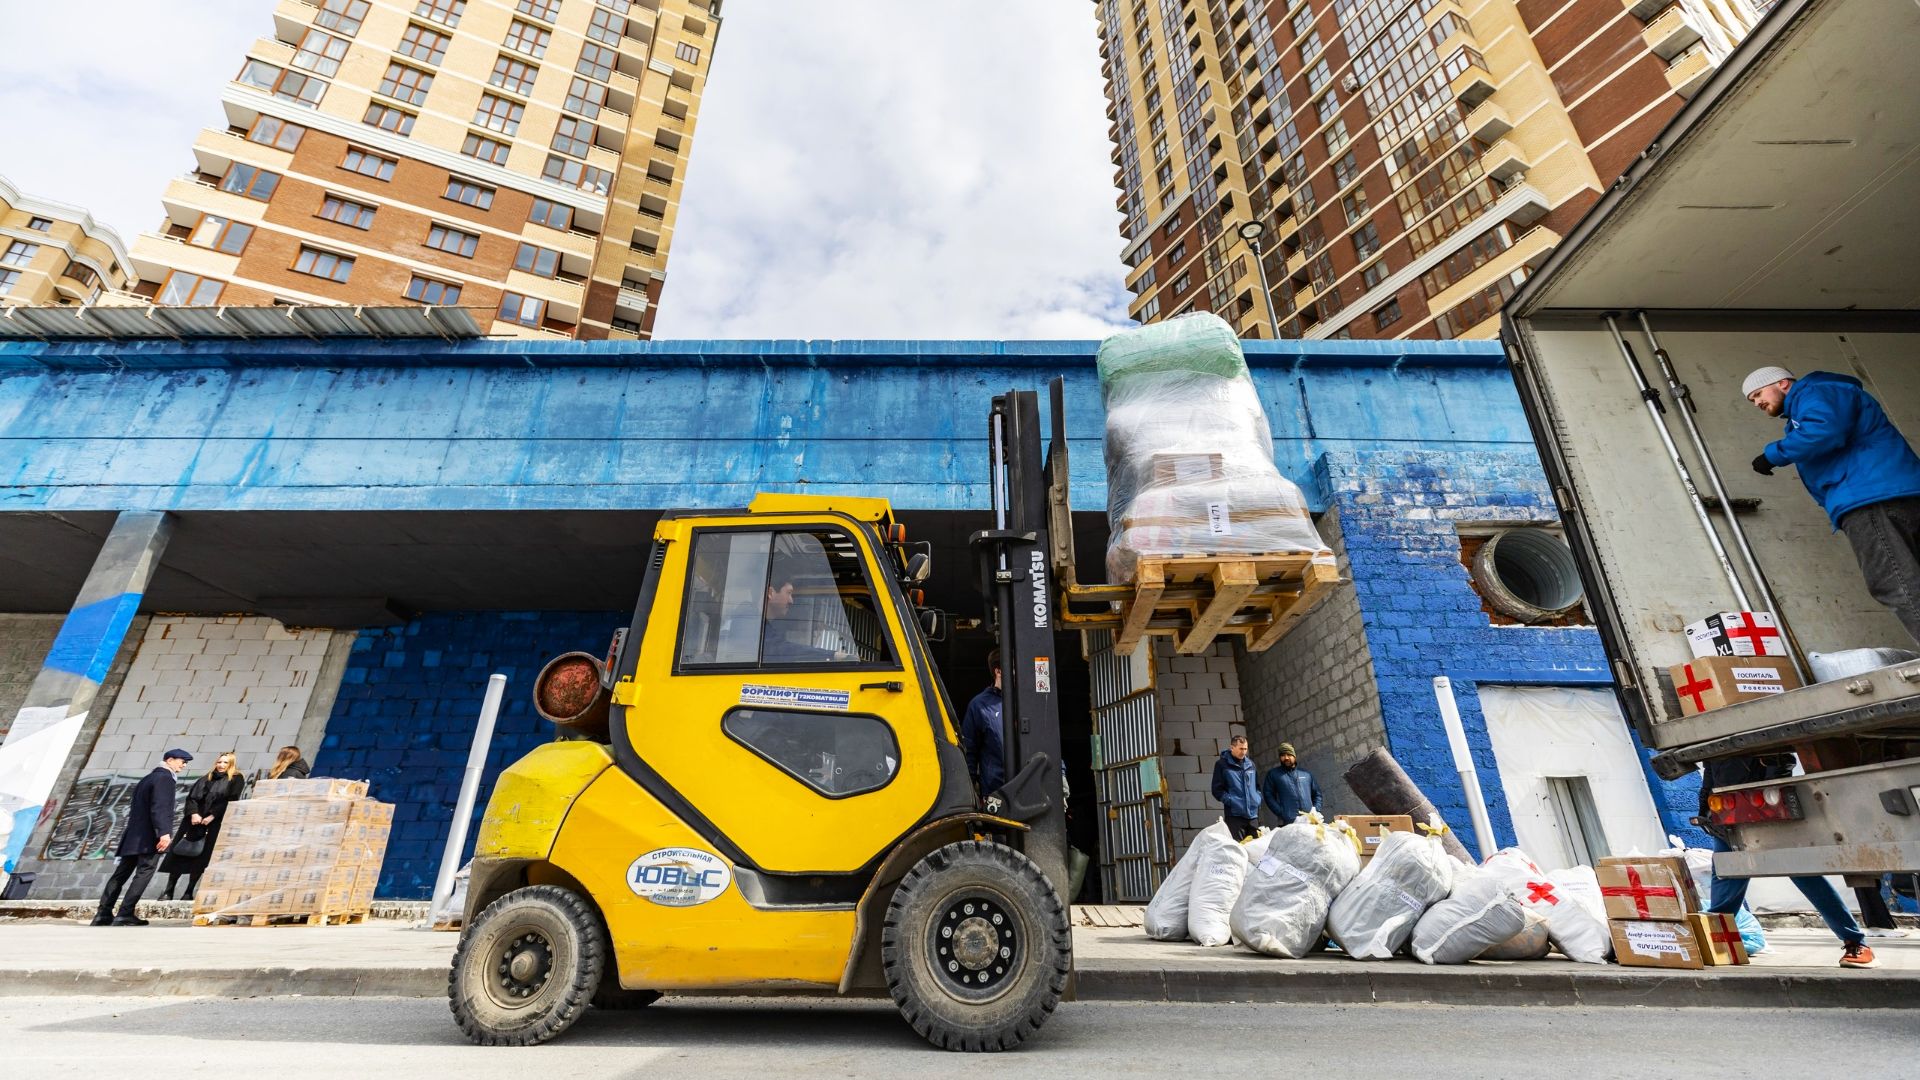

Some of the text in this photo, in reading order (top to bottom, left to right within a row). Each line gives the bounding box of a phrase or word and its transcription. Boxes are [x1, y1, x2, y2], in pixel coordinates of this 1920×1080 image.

[1029, 551, 1047, 628] KOMATSU
[1716, 643, 1732, 656] XL
[742, 687, 798, 698] ФОРКЛИФТ
[1636, 943, 1677, 951] ГОСПИТАЛЬ
